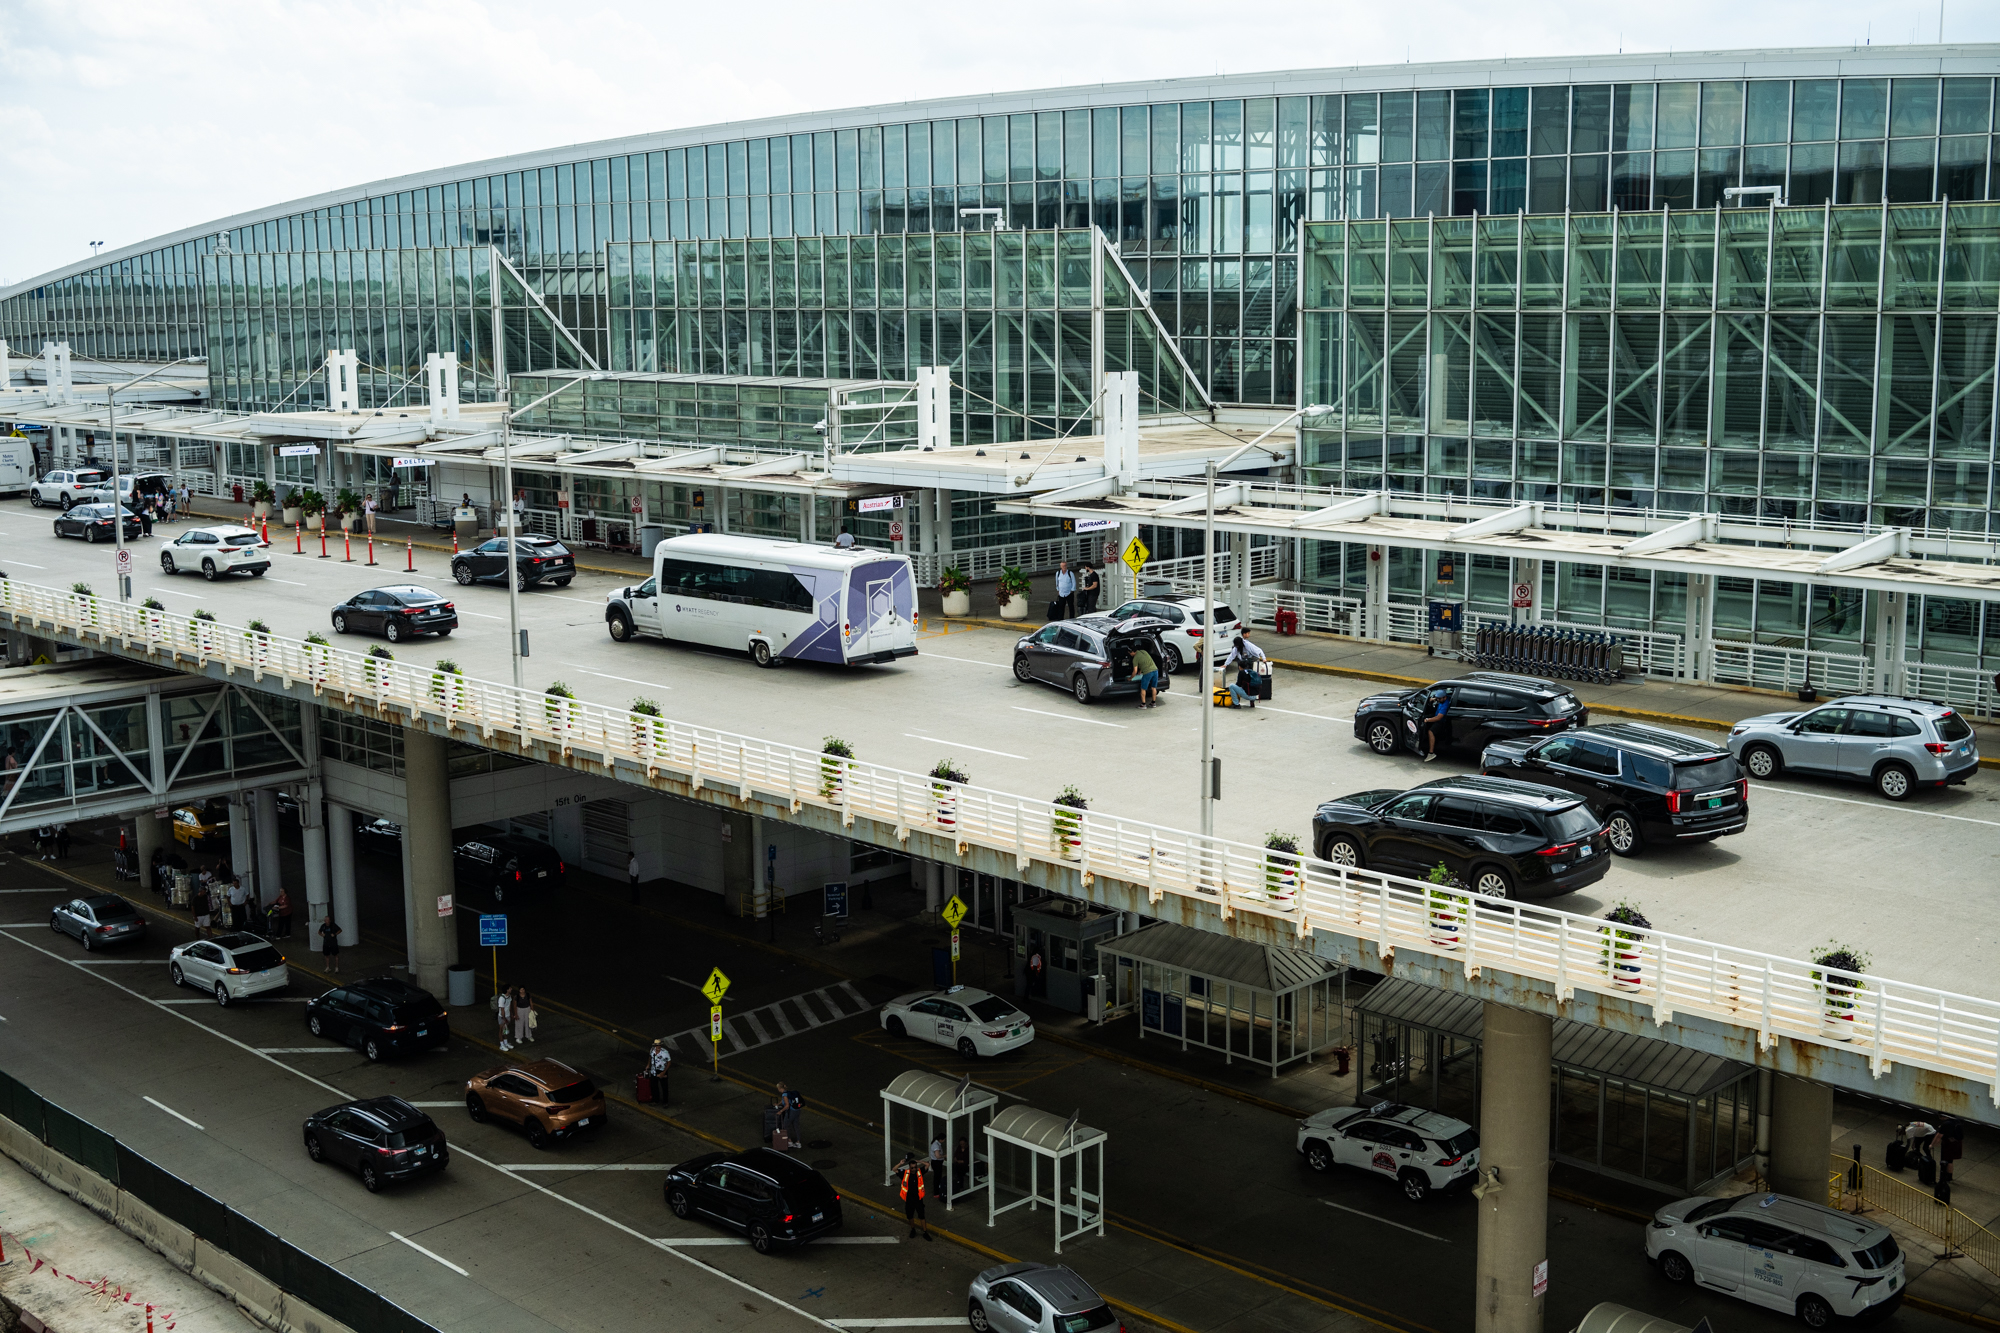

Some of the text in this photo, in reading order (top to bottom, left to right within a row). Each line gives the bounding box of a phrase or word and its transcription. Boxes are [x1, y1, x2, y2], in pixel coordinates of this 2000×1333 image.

[849, 501, 857, 510] 5C
[1064, 520, 1072, 531] 5C
[698, 608, 720, 617] REGENCY
[555, 794, 587, 807] 15ft 0in
